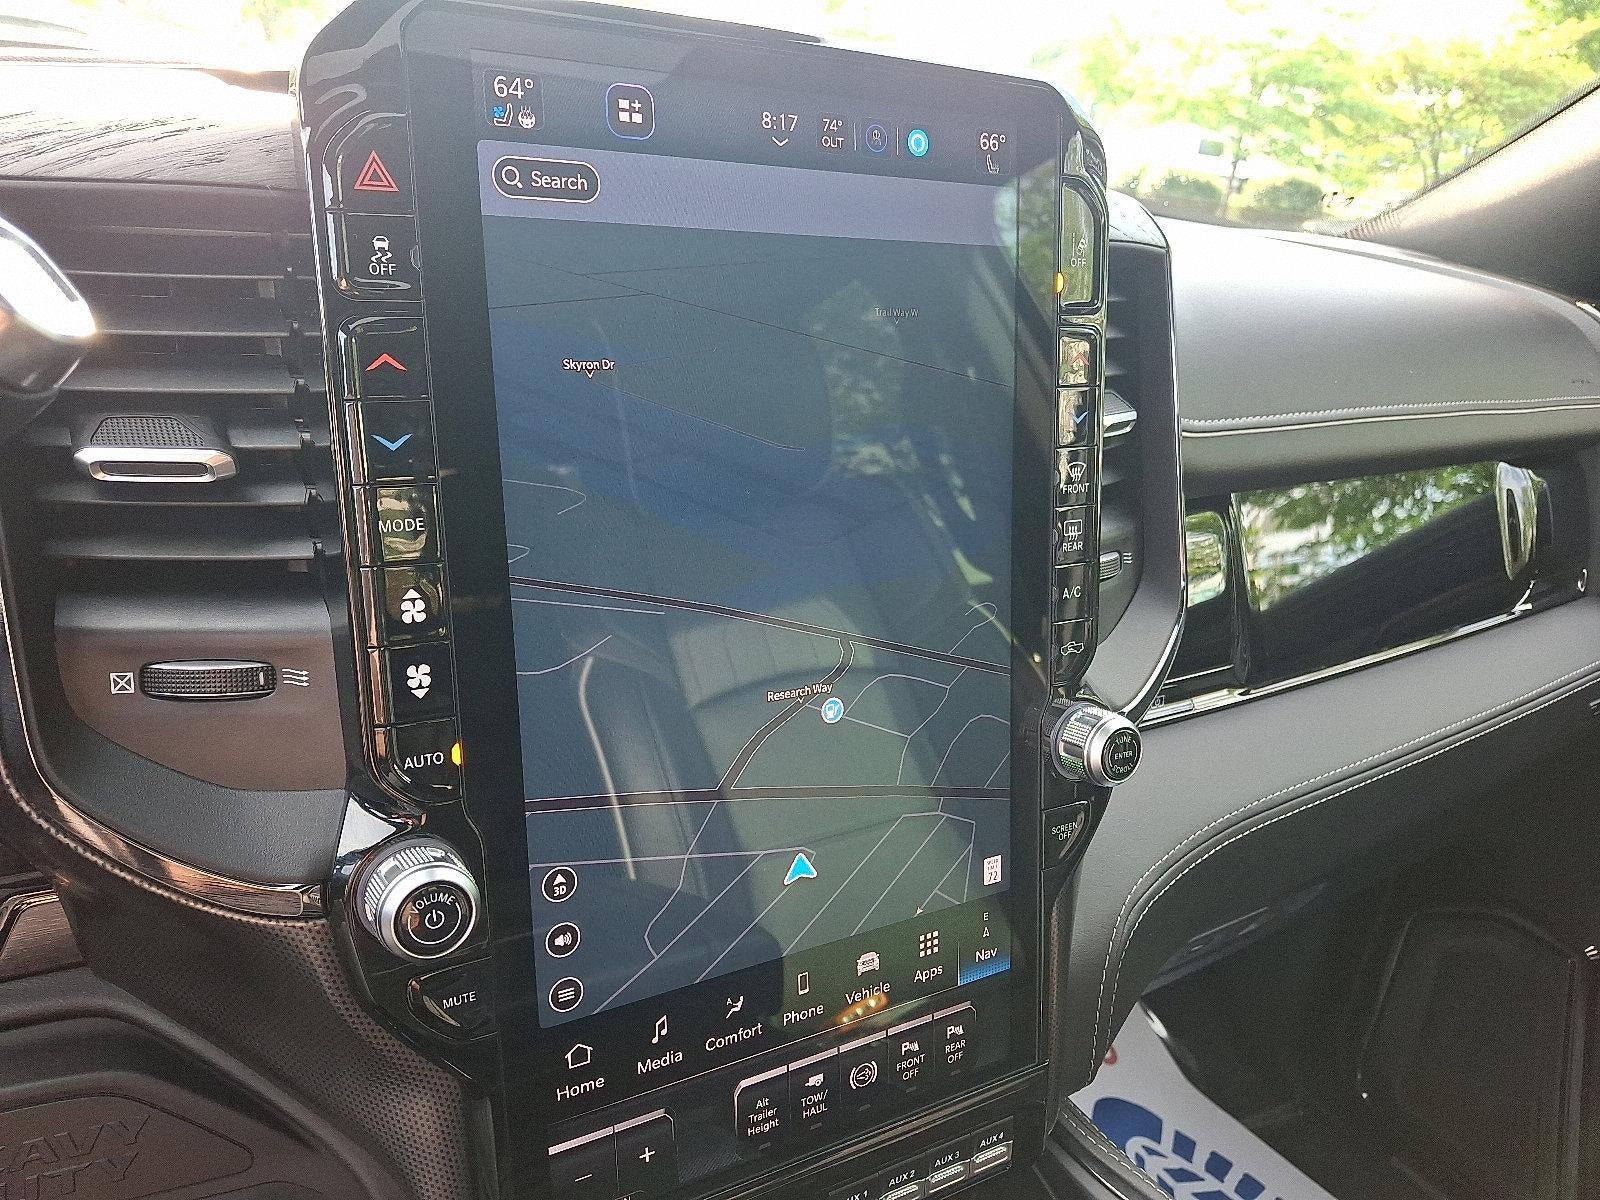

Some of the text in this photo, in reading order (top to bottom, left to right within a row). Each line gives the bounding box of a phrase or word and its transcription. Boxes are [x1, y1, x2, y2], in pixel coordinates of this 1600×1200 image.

[493, 75, 534, 99] 64°
[761, 111, 798, 132] 8:17
[822, 136, 844, 148] OUT
[531, 170, 588, 191] Search
[369, 262, 397, 276] OFF
[1070, 258, 1087, 267] OFF
[562, 358, 615, 372] Skyron Dr
[1062, 483, 1090, 495] FRONT
[378, 517, 426, 533] MODE
[1062, 541, 1084, 553] REAR
[1062, 585, 1082, 600] A/C
[767, 683, 833, 701] Research Way
[403, 752, 444, 770] AUTO
[1114, 750, 1133, 760] ENTER
[1051, 821, 1078, 835] SCREEN
[1058, 831, 1072, 841] OFF
[553, 885, 567, 897] 3D
[411, 892, 456, 915] VOLUME
[975, 947, 998, 963] Nav
[913, 964, 943, 983] Apps
[442, 991, 477, 1009] MUTE
[845, 981, 891, 1005] Vehicle
[783, 1003, 824, 1026] Phone
[705, 1022, 763, 1051] Comfort
[945, 1039, 966, 1054] REAR
[637, 1050, 683, 1075] Media
[896, 1053, 925, 1072] FRONT
[947, 1051, 963, 1064] OFF
[902, 1067, 919, 1081] OFF
[556, 1076, 605, 1102] Home
[756, 1097, 770, 1110] Alt
[801, 1089, 829, 1108] TOW/
[748, 1106, 778, 1124] Trailer
[802, 1102, 828, 1119] HAUL
[747, 1117, 780, 1138] Height
[980, 1133, 998, 1148] AUX
[934, 1154, 954, 1168] AUX
[888, 1173, 910, 1188] AUX
